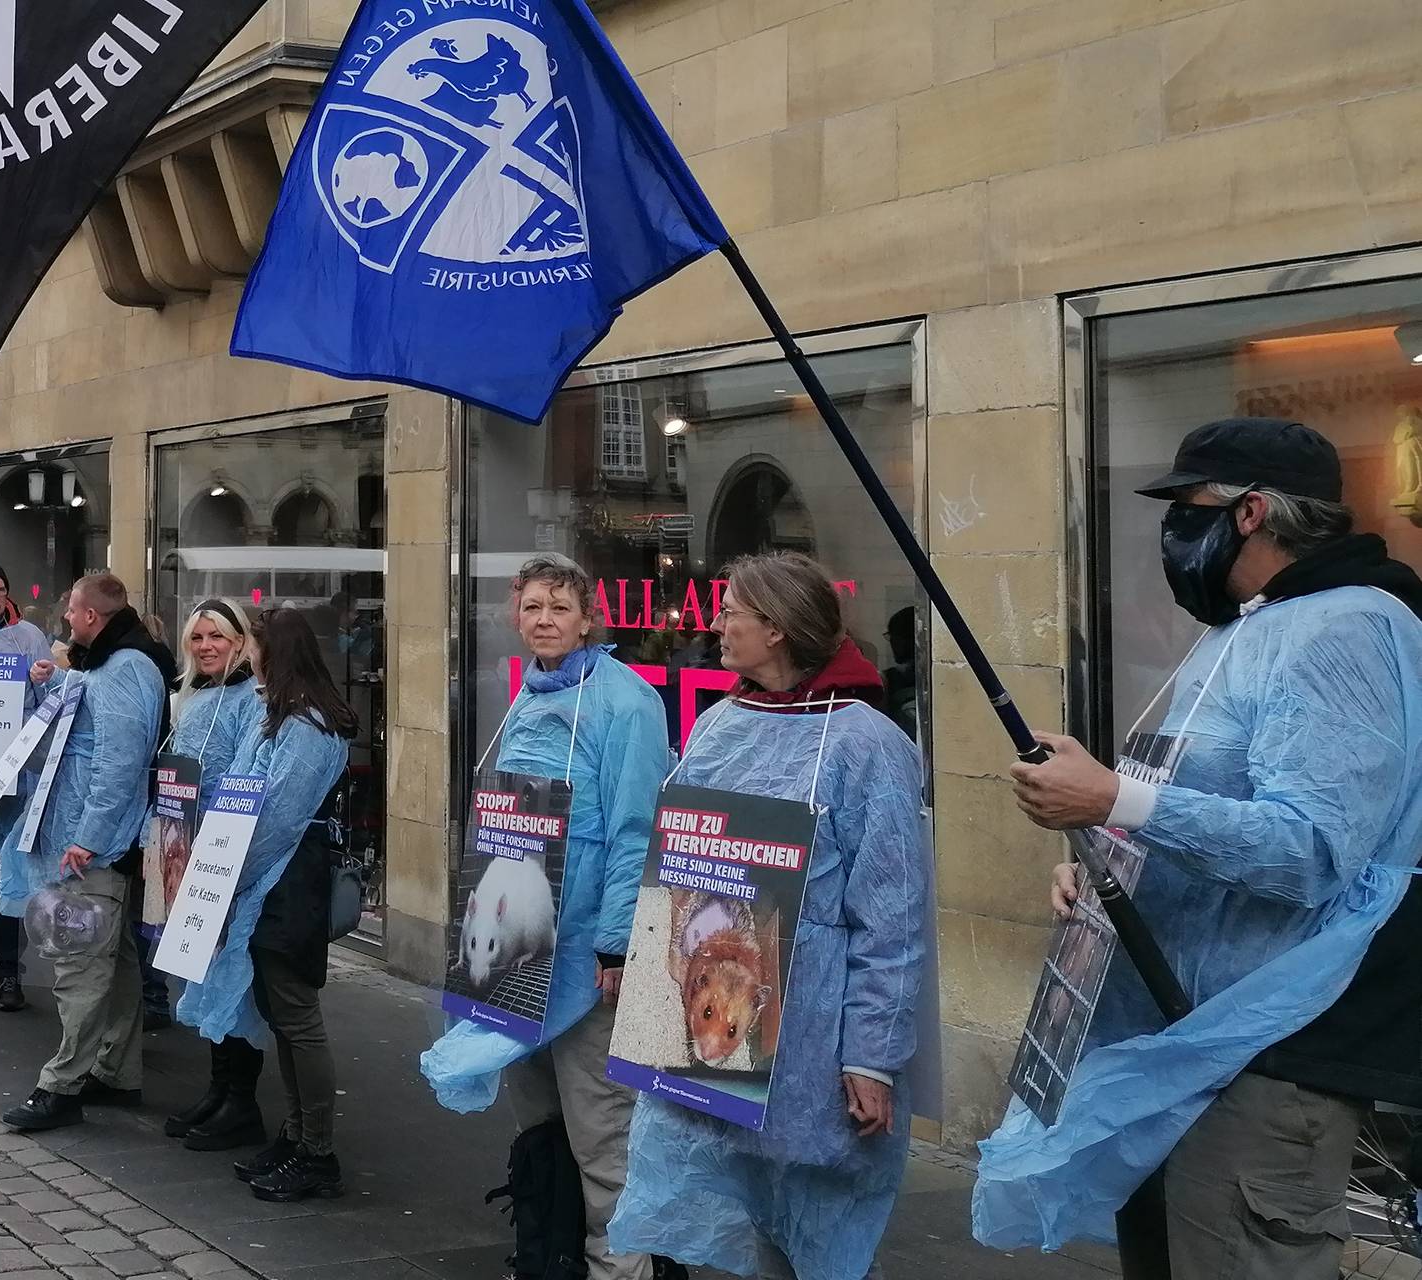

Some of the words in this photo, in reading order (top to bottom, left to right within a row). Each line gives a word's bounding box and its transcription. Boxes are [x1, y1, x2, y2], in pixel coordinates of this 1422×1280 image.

[219, 777, 265, 793] TIERVERSUCHE
[214, 796, 256, 812] ABSCHAFFEN
[476, 793, 516, 812] STOPPT
[480, 811, 560, 836] TIERVERSUCHE
[660, 810, 699, 832] NEIN
[700, 815, 723, 835] ZU
[478, 828, 489, 840] FÜR
[491, 832, 505, 844] EINE
[505, 834, 545, 852] FORSCHUNG
[476, 841, 494, 854] OHNE
[494, 844, 524, 860] TIERLEID!
[666, 833, 801, 869] TIERVERSUCHEN
[193, 859, 234, 878] Paracetamol
[662, 854, 689, 870] TIERE
[689, 859, 713, 875] SIND
[714, 864, 746, 881] KEINE
[188, 884, 198, 898] für
[198, 887, 221, 904] Katzen
[658, 868, 756, 900] MESSINSTRUMENTE!
[184, 913, 204, 932] giftig
